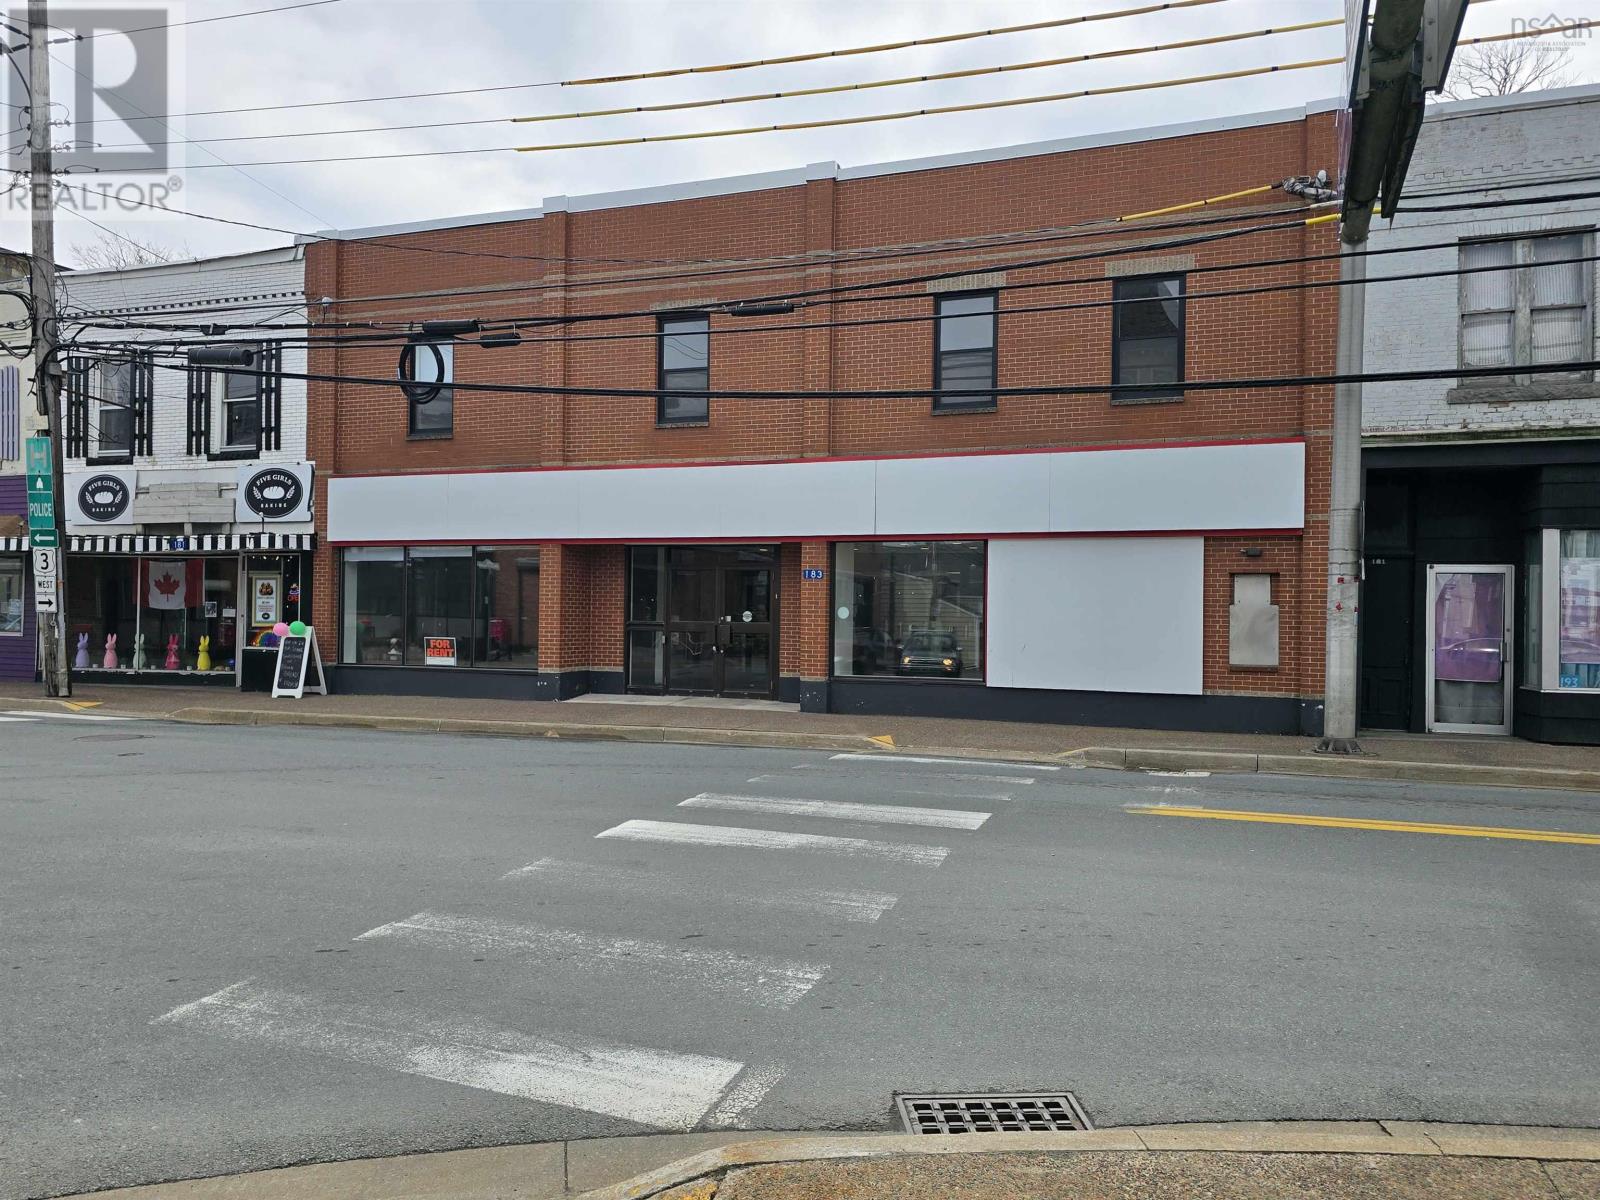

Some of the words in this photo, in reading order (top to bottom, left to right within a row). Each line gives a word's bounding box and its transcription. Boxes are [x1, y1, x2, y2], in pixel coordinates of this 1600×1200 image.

[88, 481, 101, 491] FIVE
[102, 480, 120, 490] GIRLS
[256, 475, 271, 486] FIVE
[272, 474, 292, 485] GIRLS
[29, 503, 52, 517] POLICE
[40, 553, 49, 570] 3
[805, 570, 823, 579] 183
[38, 581, 53, 589] WEST
[430, 640, 450, 648] FOR
[427, 648, 454, 657] RENT
[1561, 677, 1578, 688] 193
